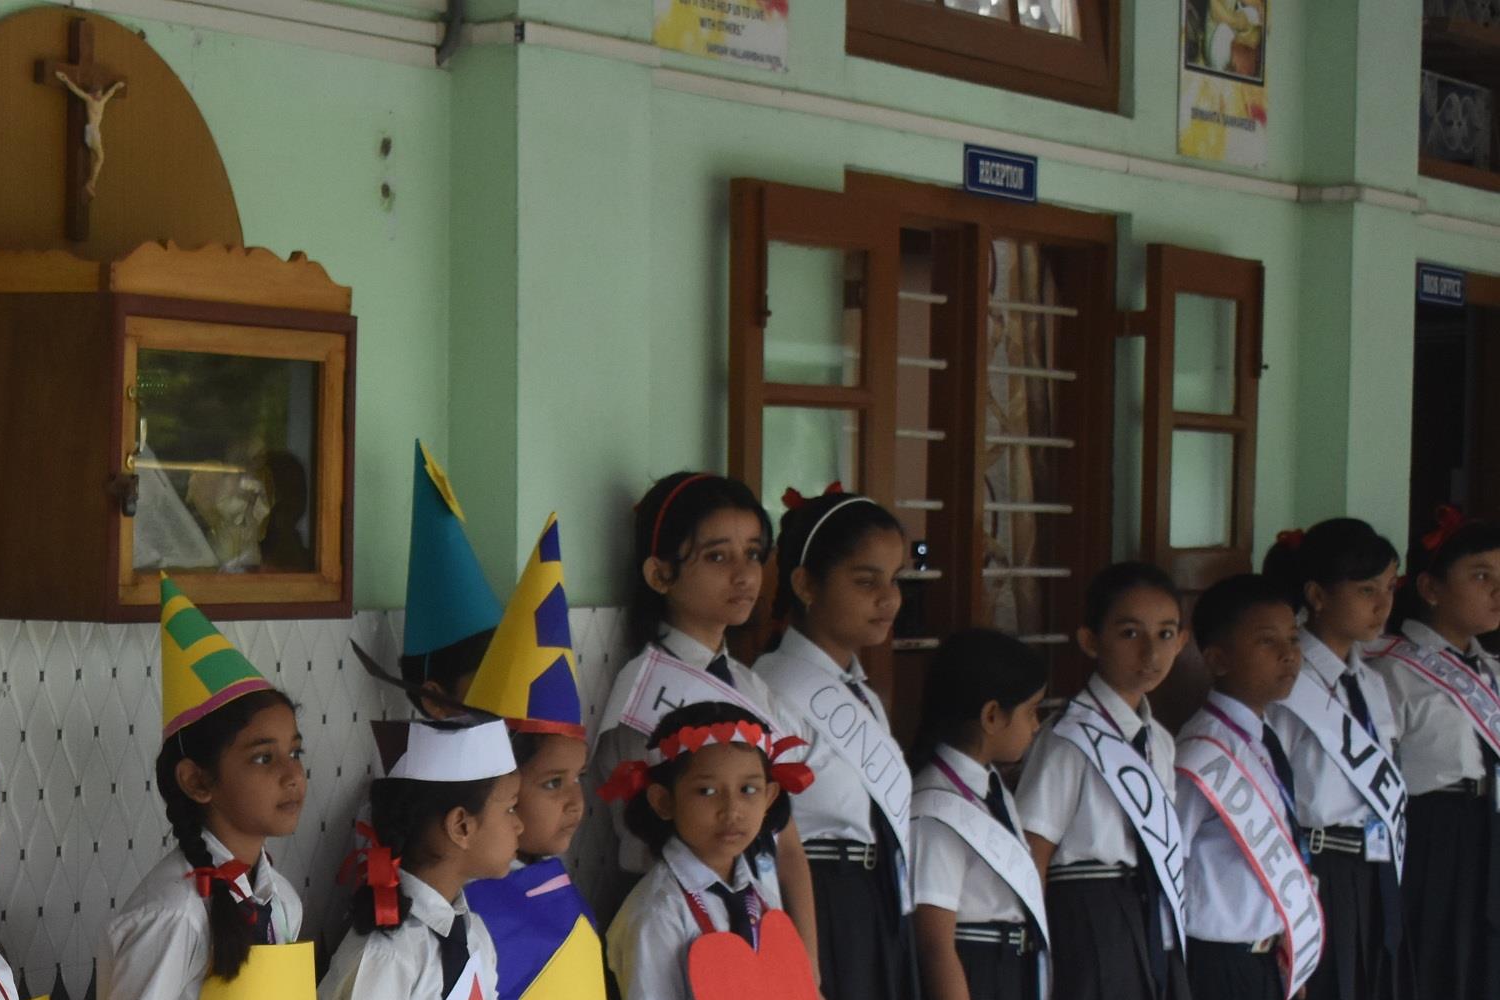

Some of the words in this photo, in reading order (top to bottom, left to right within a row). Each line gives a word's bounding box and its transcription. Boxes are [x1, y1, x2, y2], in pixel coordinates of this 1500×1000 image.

[979, 159, 1024, 190] RECEPTION
[1079, 721, 1185, 912] ADVE
[1198, 755, 1323, 985] ADJECTIV
[1340, 712, 1408, 862] VERB
